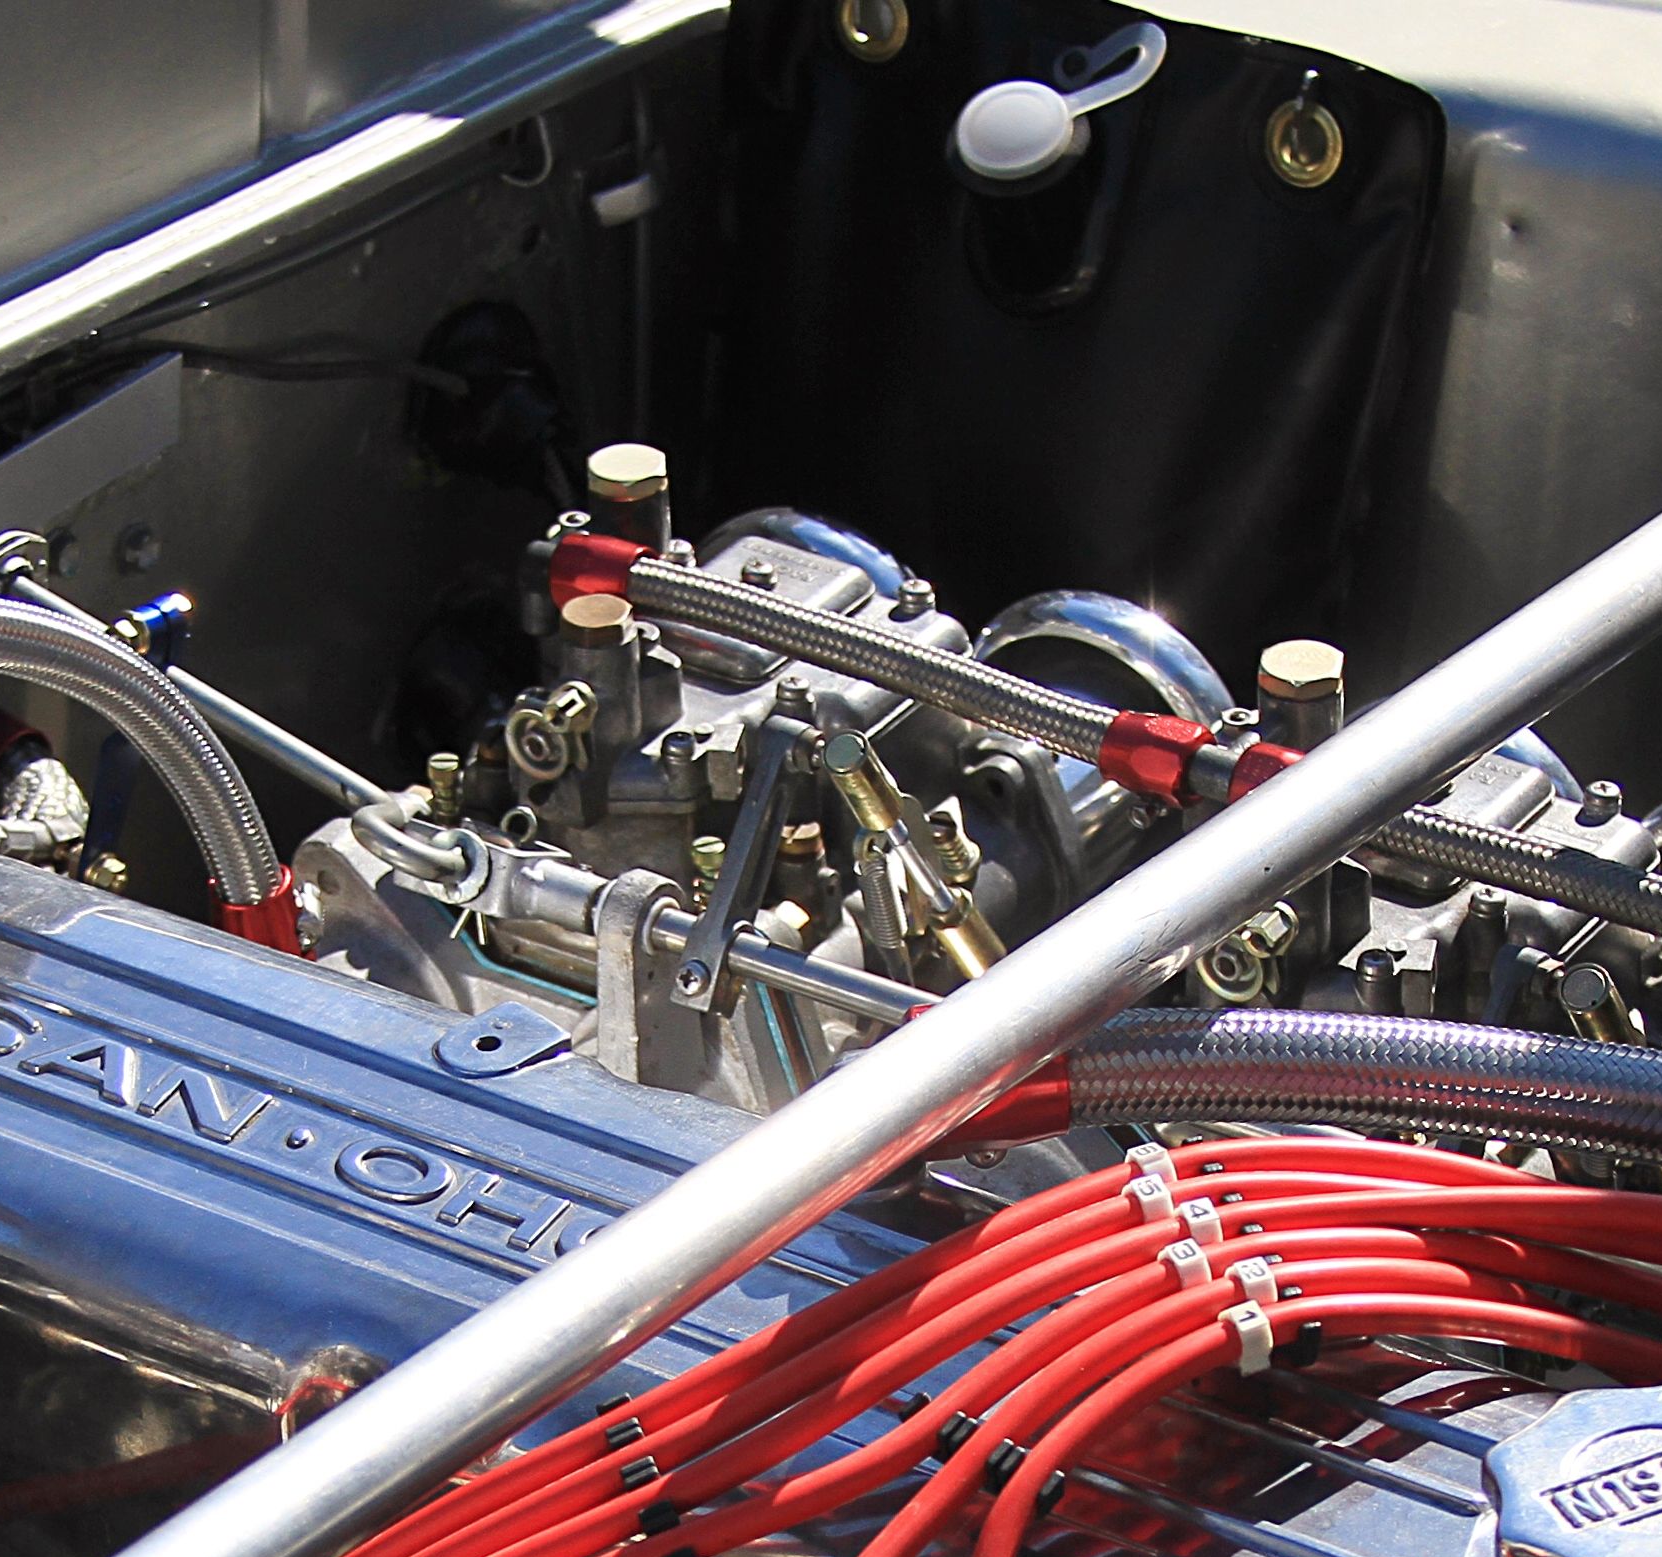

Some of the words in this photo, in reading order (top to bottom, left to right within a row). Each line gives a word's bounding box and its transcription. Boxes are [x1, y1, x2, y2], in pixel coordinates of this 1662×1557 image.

[1138, 1179, 1162, 1196] 5
[1190, 1204, 1211, 1218] 4
[1171, 1242, 1197, 1260] 3
[1241, 1262, 1266, 1280] 2
[1239, 1309, 1259, 1323] 1
